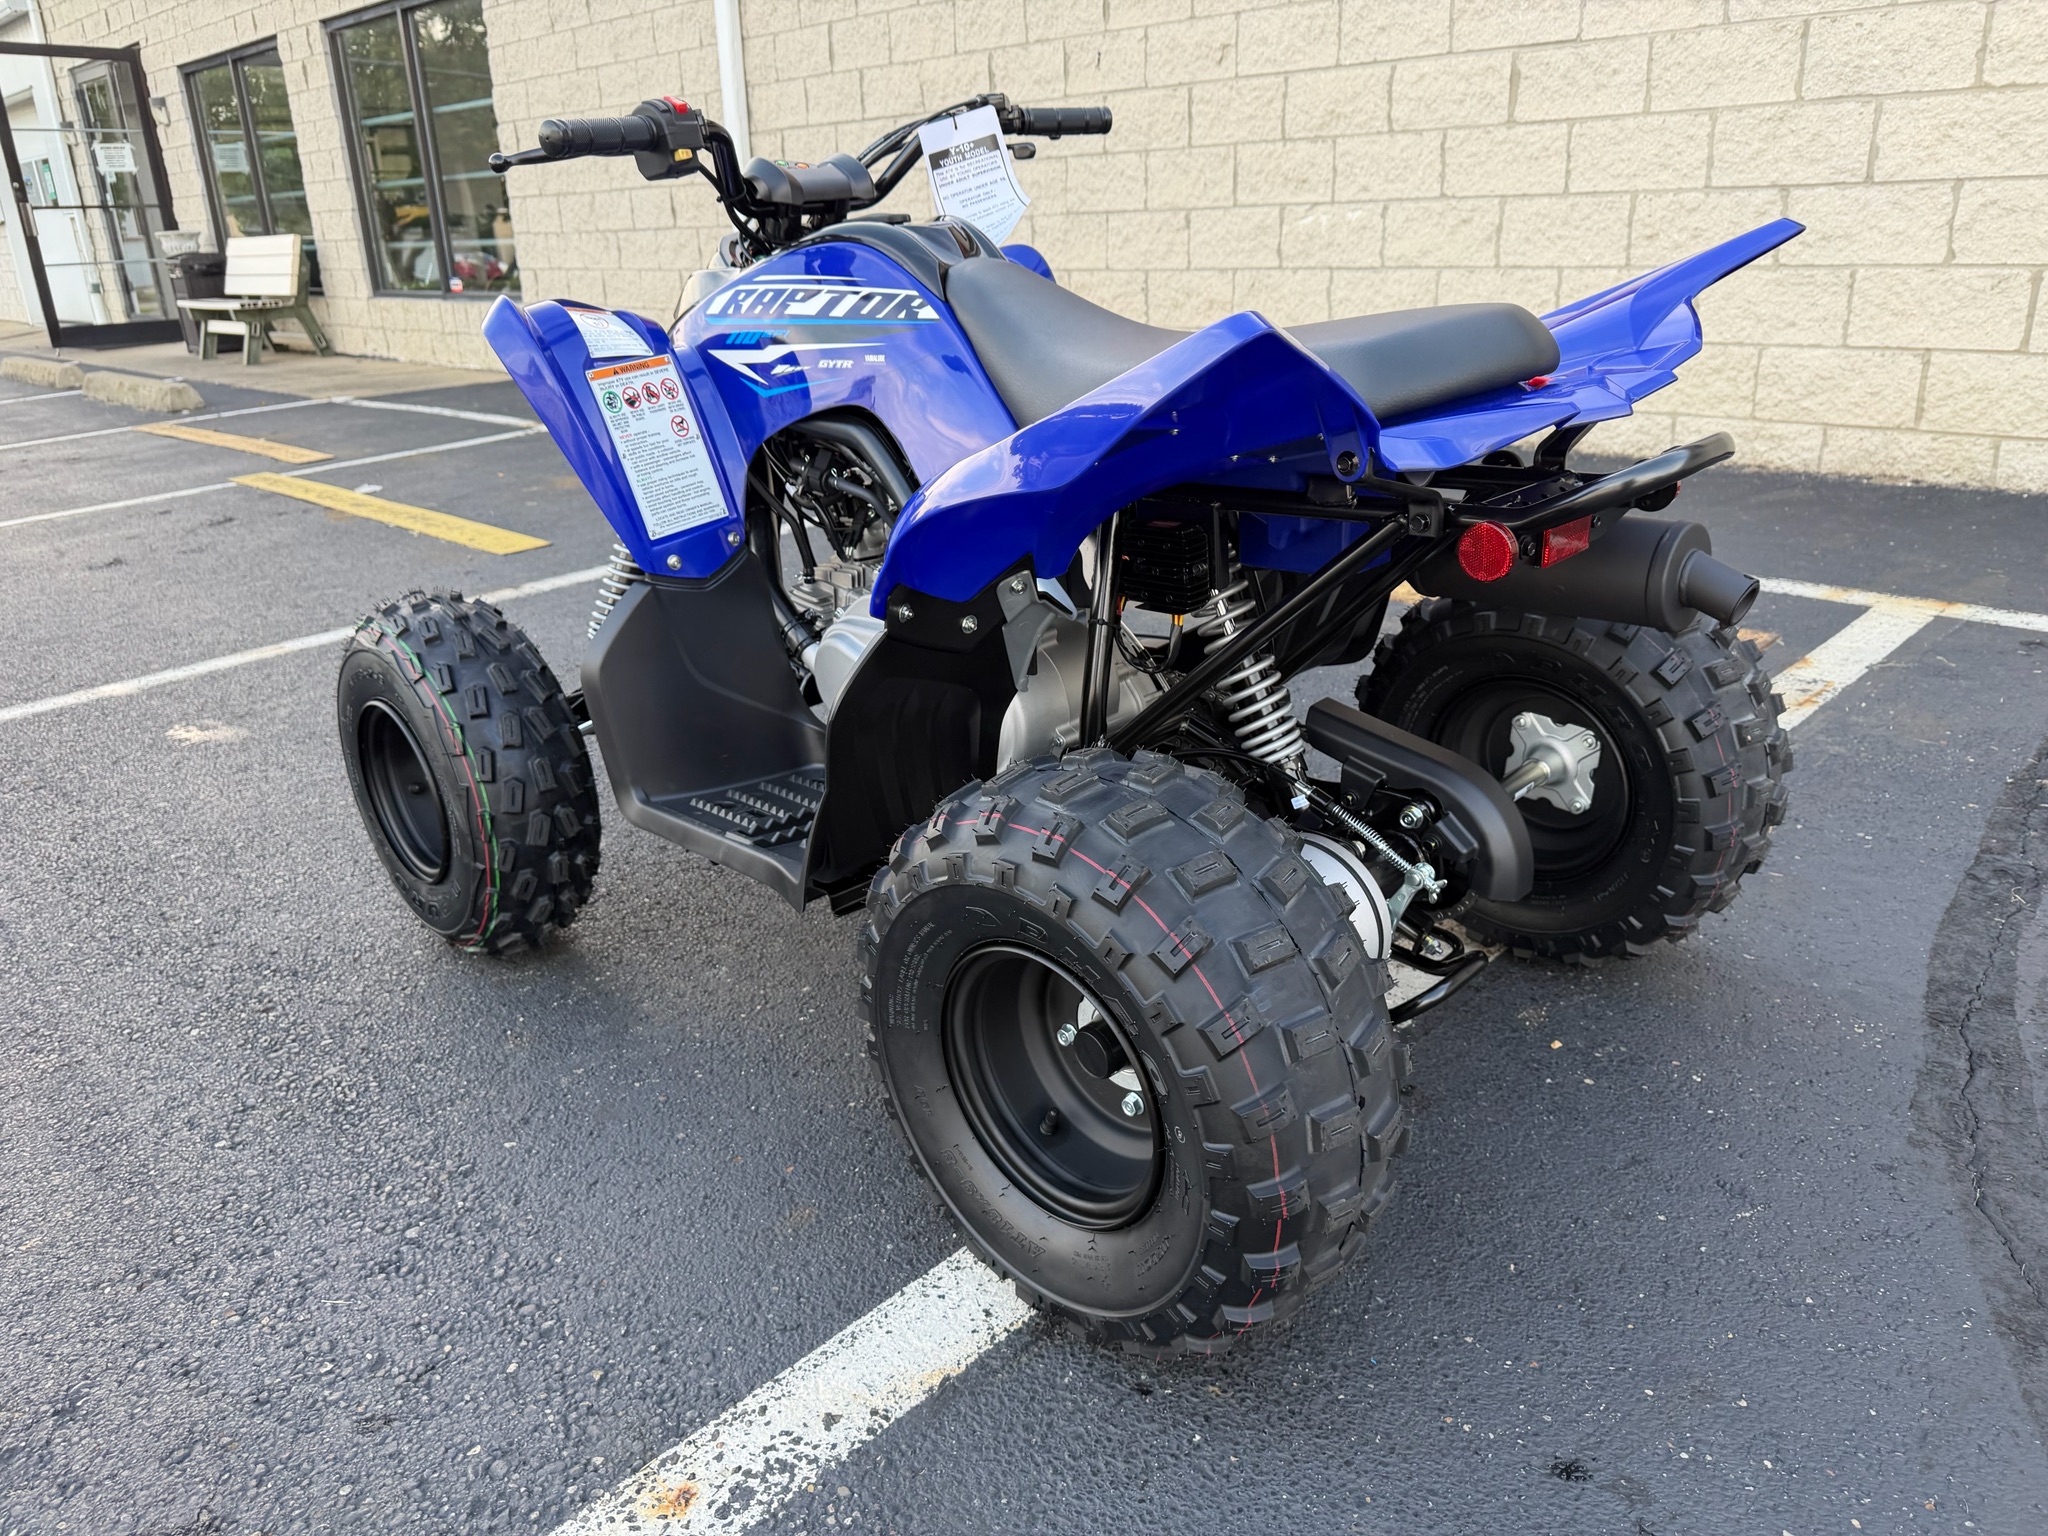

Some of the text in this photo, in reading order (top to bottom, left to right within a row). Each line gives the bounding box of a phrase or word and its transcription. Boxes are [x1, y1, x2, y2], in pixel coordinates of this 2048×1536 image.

[939, 146, 989, 167] YOUTH MODEL
[710, 286, 937, 320] RAPTOR
[620, 361, 650, 374] WARNING
[817, 359, 855, 368] GYTR
